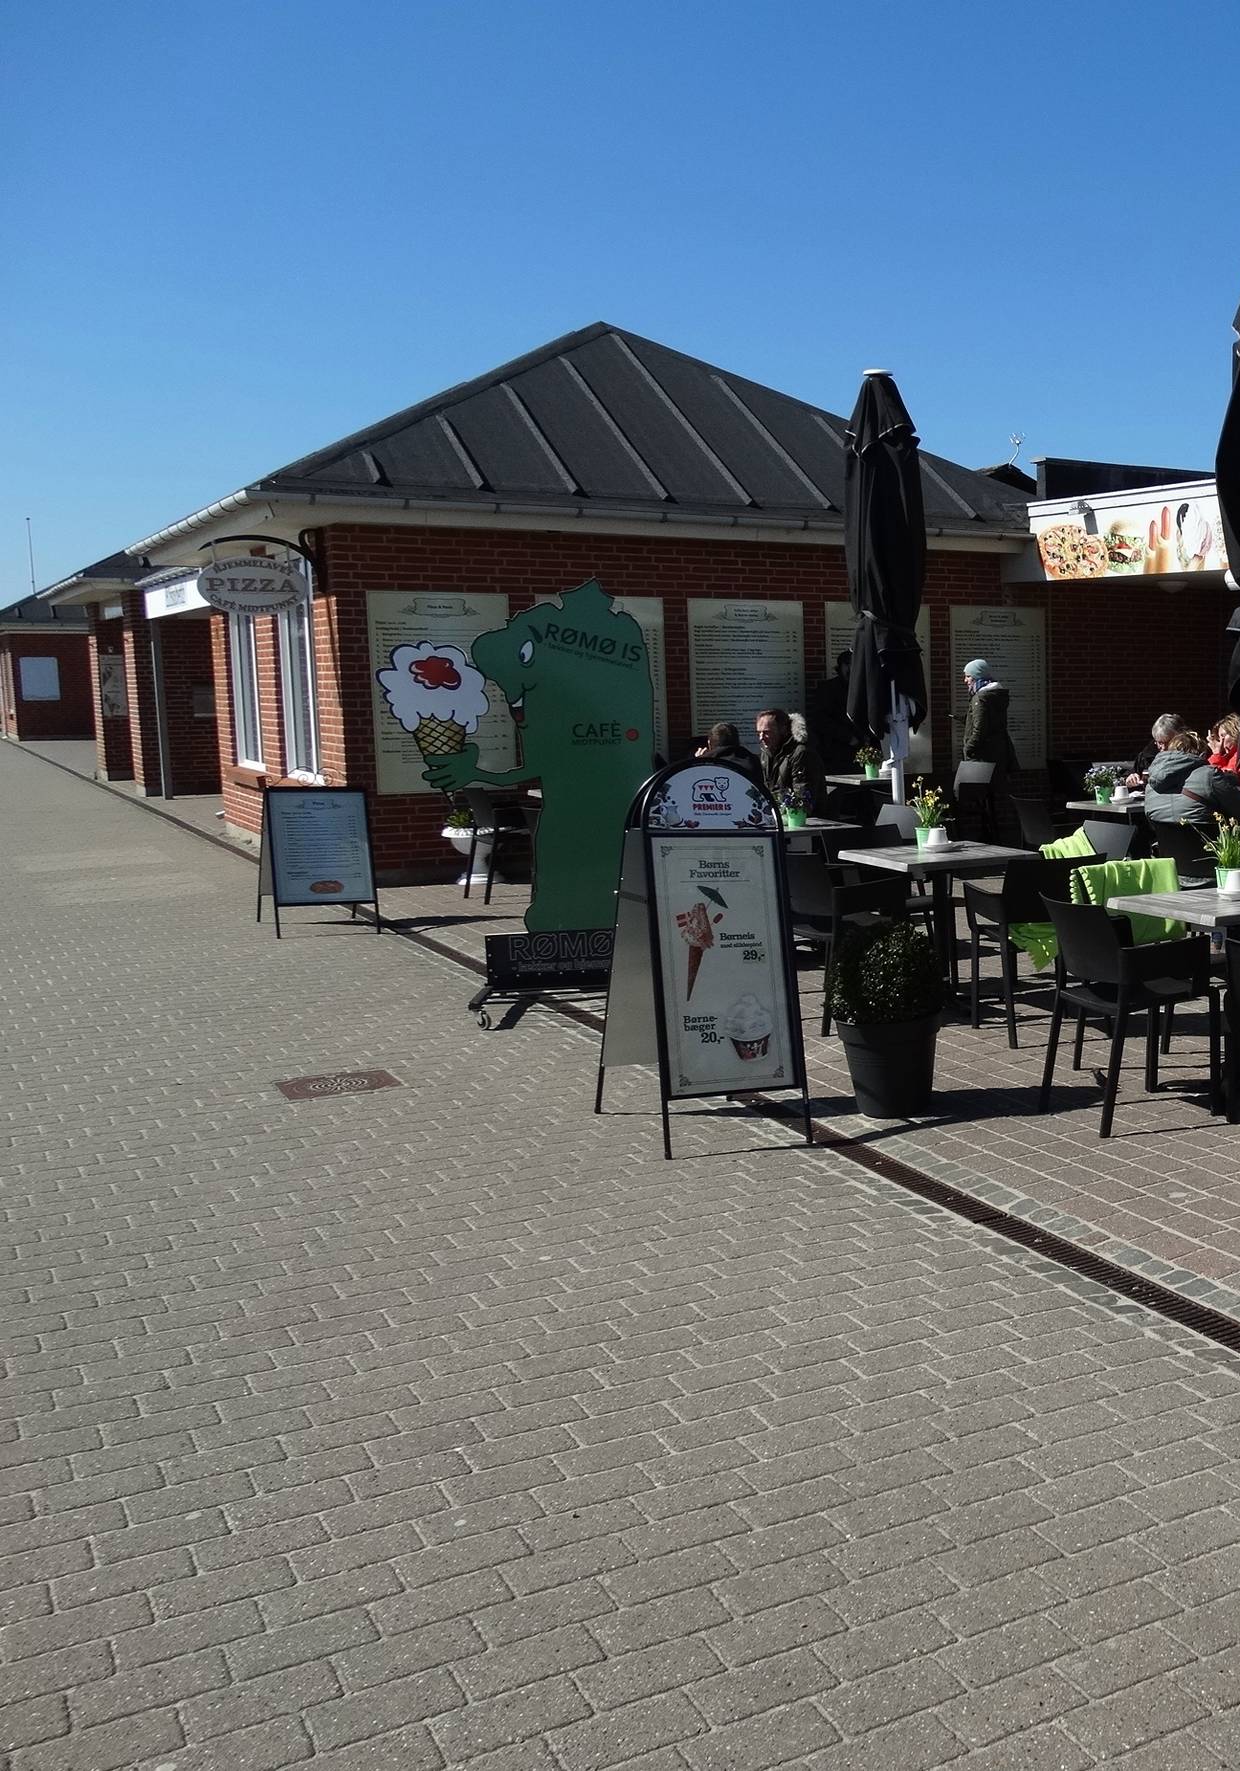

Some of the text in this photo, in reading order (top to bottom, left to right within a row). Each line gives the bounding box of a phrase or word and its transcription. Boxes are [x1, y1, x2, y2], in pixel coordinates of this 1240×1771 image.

[205, 577, 300, 593] PIZZA
[544, 622, 643, 662] RØMØ IS
[692, 803, 732, 811] PREMIER IS
[698, 859, 731, 870] Børns
[688, 868, 741, 879] Favoritter
[720, 931, 755, 941] Børneis
[508, 930, 615, 961] RØMØ
[742, 949, 766, 962] 29,-
[682, 1015, 719, 1024] Børne-
[683, 1022, 717, 1033] bæger
[700, 1031, 726, 1045] 20,-
